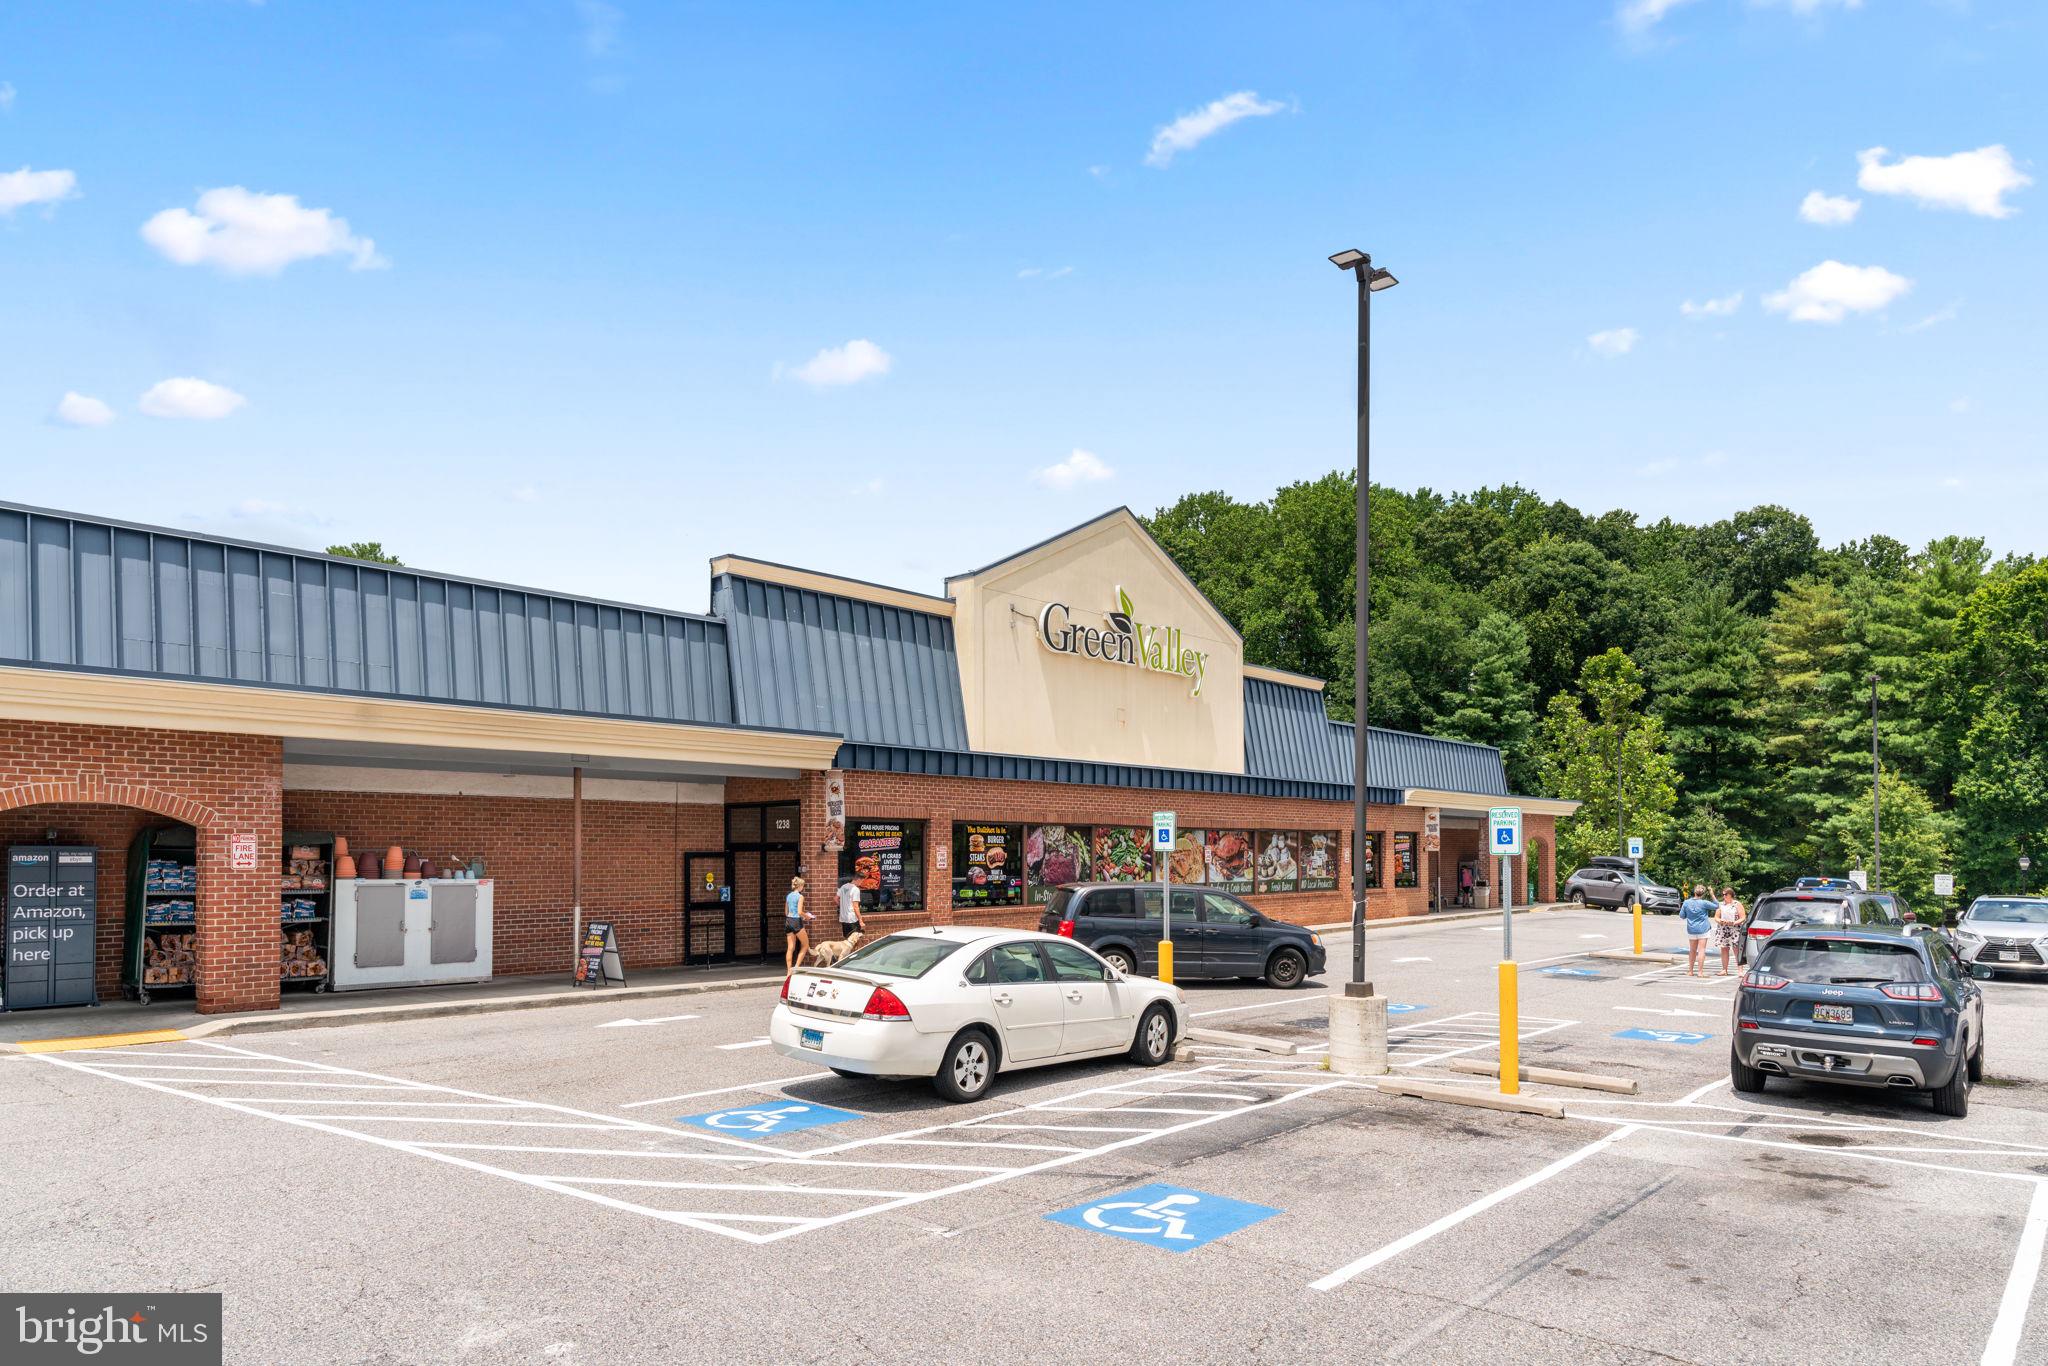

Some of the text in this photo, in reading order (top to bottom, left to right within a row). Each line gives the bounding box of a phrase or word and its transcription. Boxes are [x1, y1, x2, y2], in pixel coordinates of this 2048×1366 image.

[775, 820, 790, 829] 1238
[12, 854, 49, 862] amazon
[13, 883, 86, 897] Order at
[13, 906, 86, 919] Amazon,
[13, 926, 74, 943] pick up
[13, 948, 51, 961] here
[1822, 988, 1843, 996] Jeep
